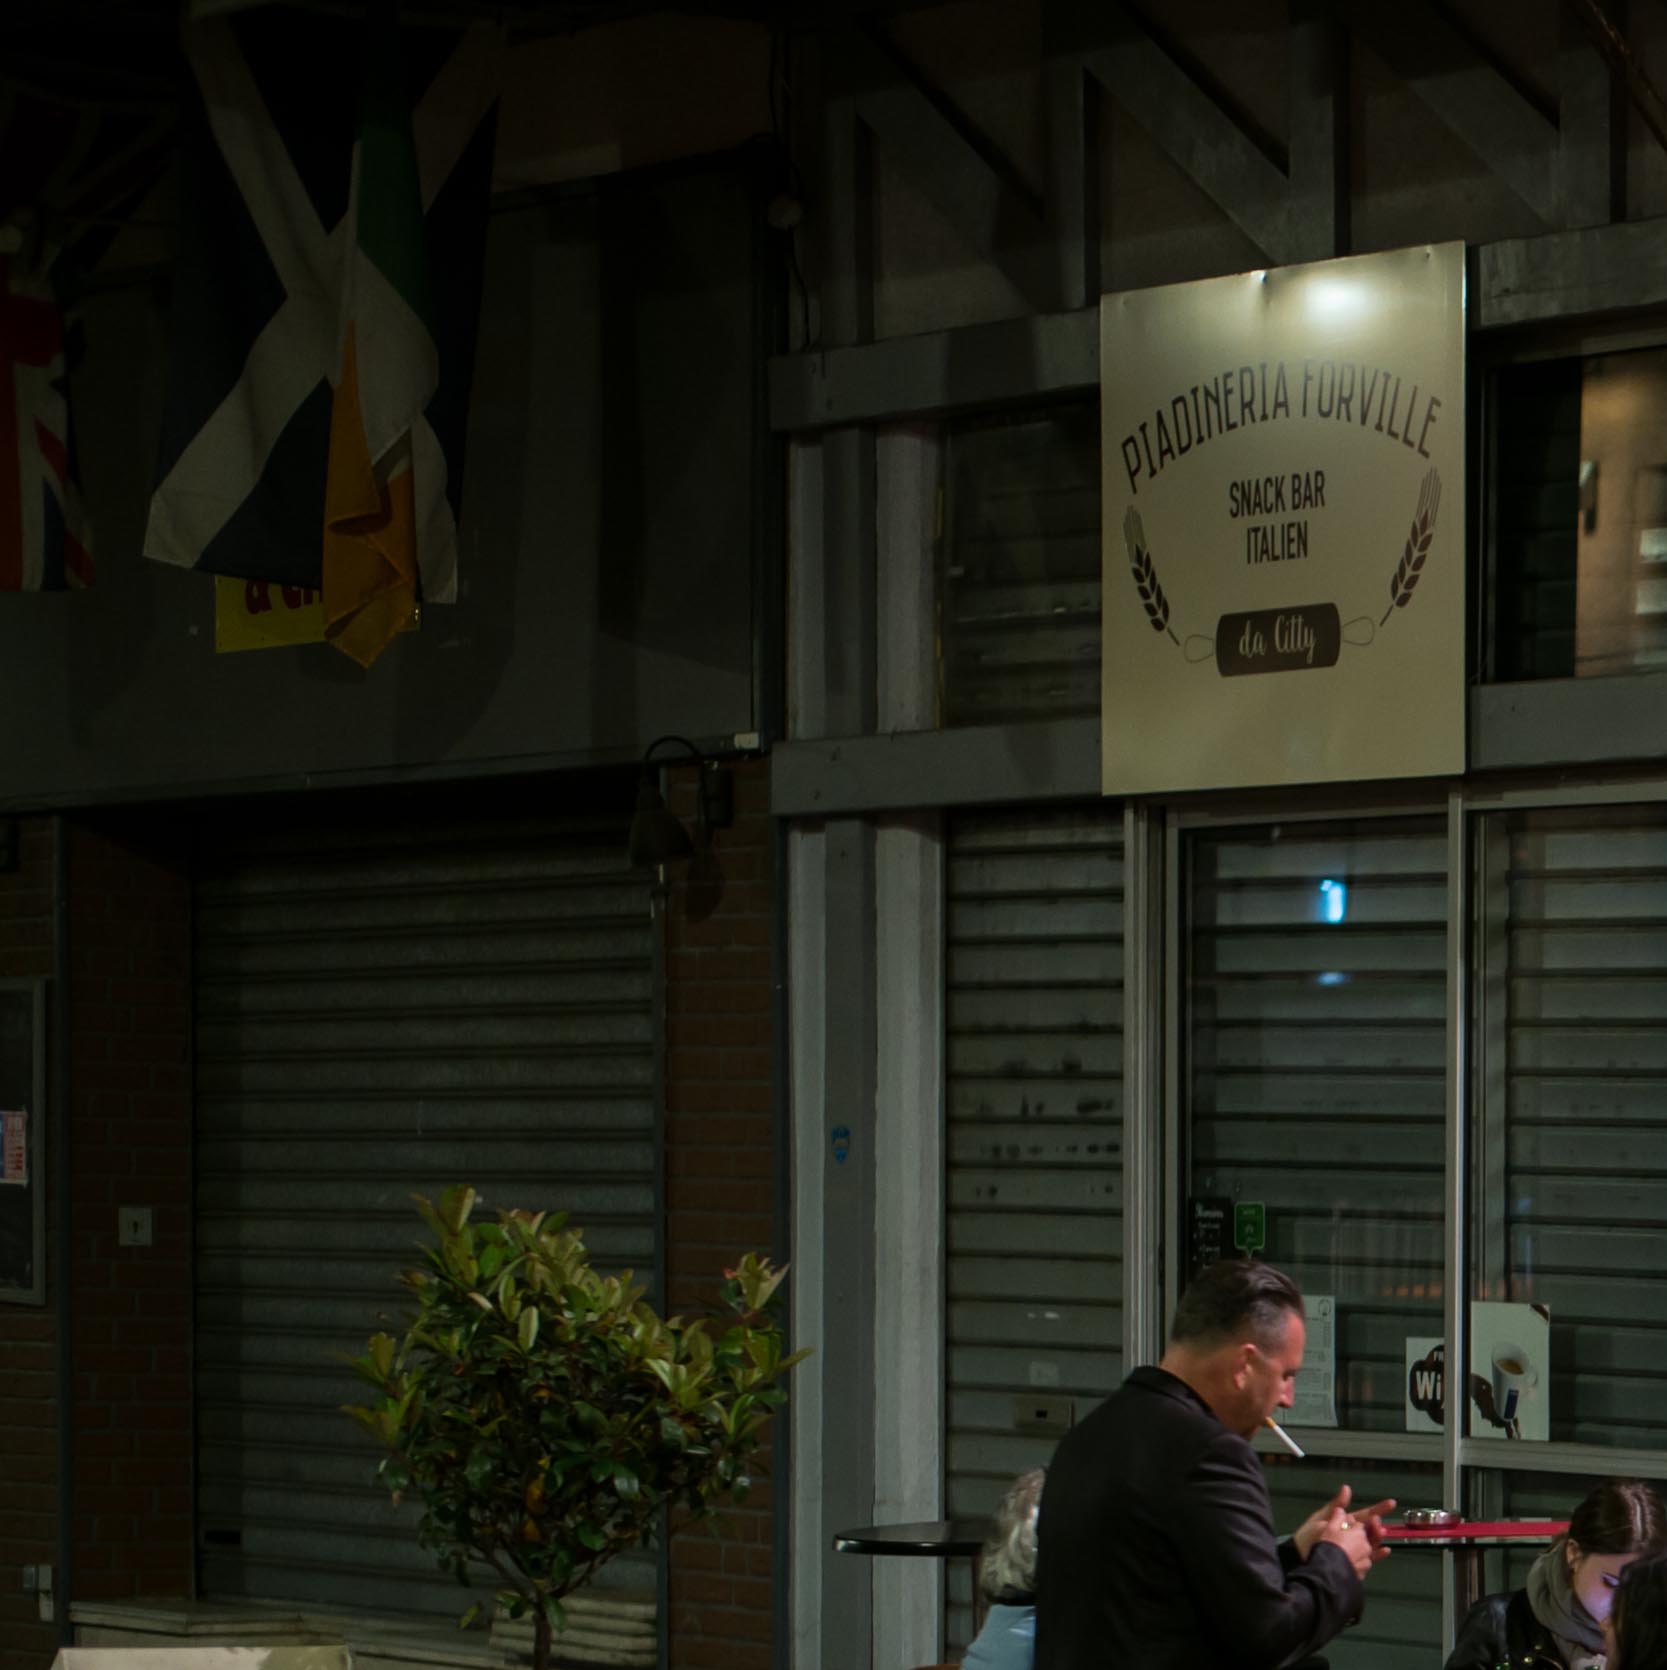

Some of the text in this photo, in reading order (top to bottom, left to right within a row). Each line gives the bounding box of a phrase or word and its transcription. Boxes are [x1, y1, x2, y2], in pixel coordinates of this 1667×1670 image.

[1122, 359, 1442, 495] PIADINERIA FORVILLE
[1229, 469, 1326, 519] SNACK BAR
[1246, 519, 1309, 564] ITALIEN
[1238, 614, 1318, 665] da Citty
